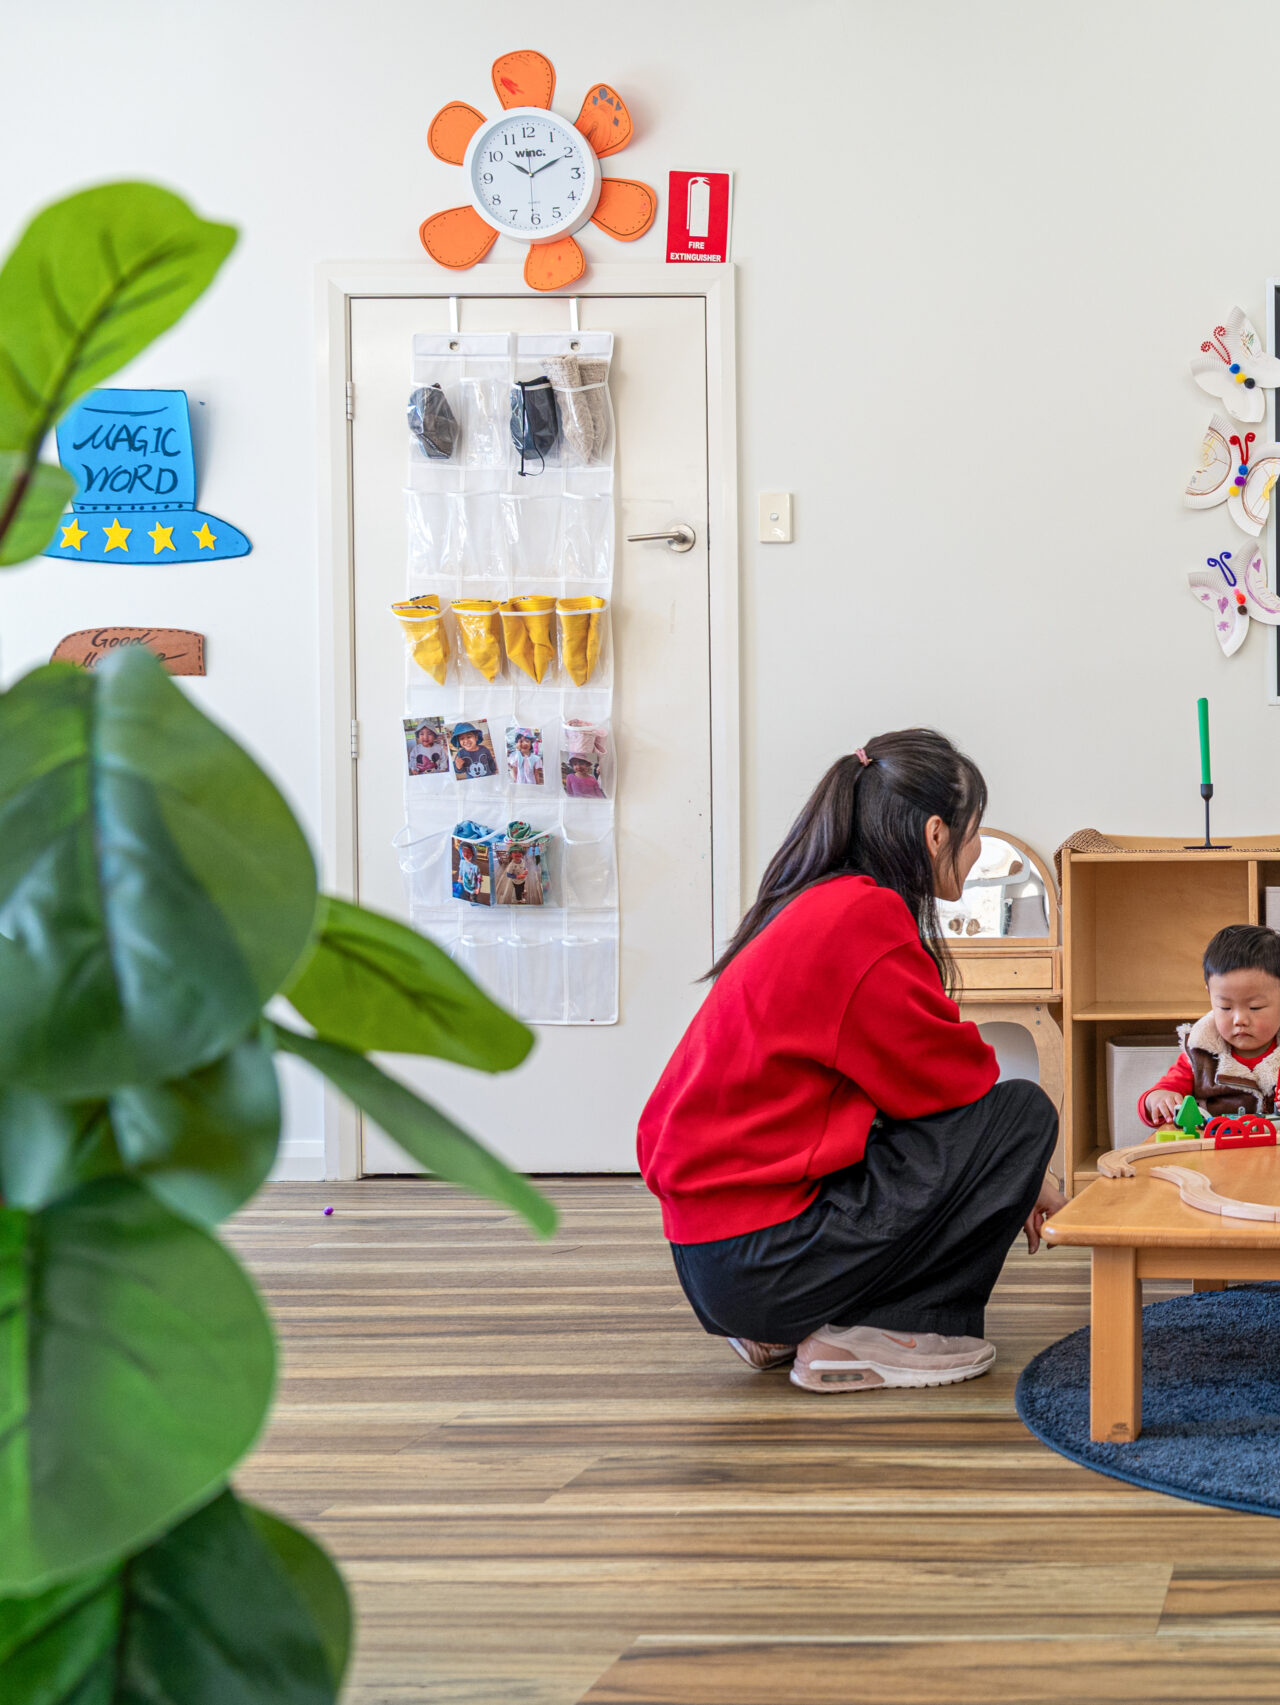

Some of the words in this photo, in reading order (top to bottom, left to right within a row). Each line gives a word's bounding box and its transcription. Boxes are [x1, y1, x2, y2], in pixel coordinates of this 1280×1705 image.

[522, 126, 536, 138] 12
[549, 131, 554, 143] 1
[504, 134, 516, 145] 11
[489, 151, 504, 162] 10
[563, 147, 573, 158] 2
[483, 172, 494, 184] 9
[571, 167, 581, 179] 3
[492, 194, 501, 206] 8
[567, 190, 576, 201] 4
[509, 209, 518, 221] 7
[552, 207, 562, 218] 5
[531, 213, 541, 225] 6
[688, 241, 705, 250] FIRE
[670, 252, 722, 263] EXTINGUISHER
[73, 424, 181, 457] MAGIC
[81, 464, 178, 494] WORD
[91, 629, 158, 650] Good
